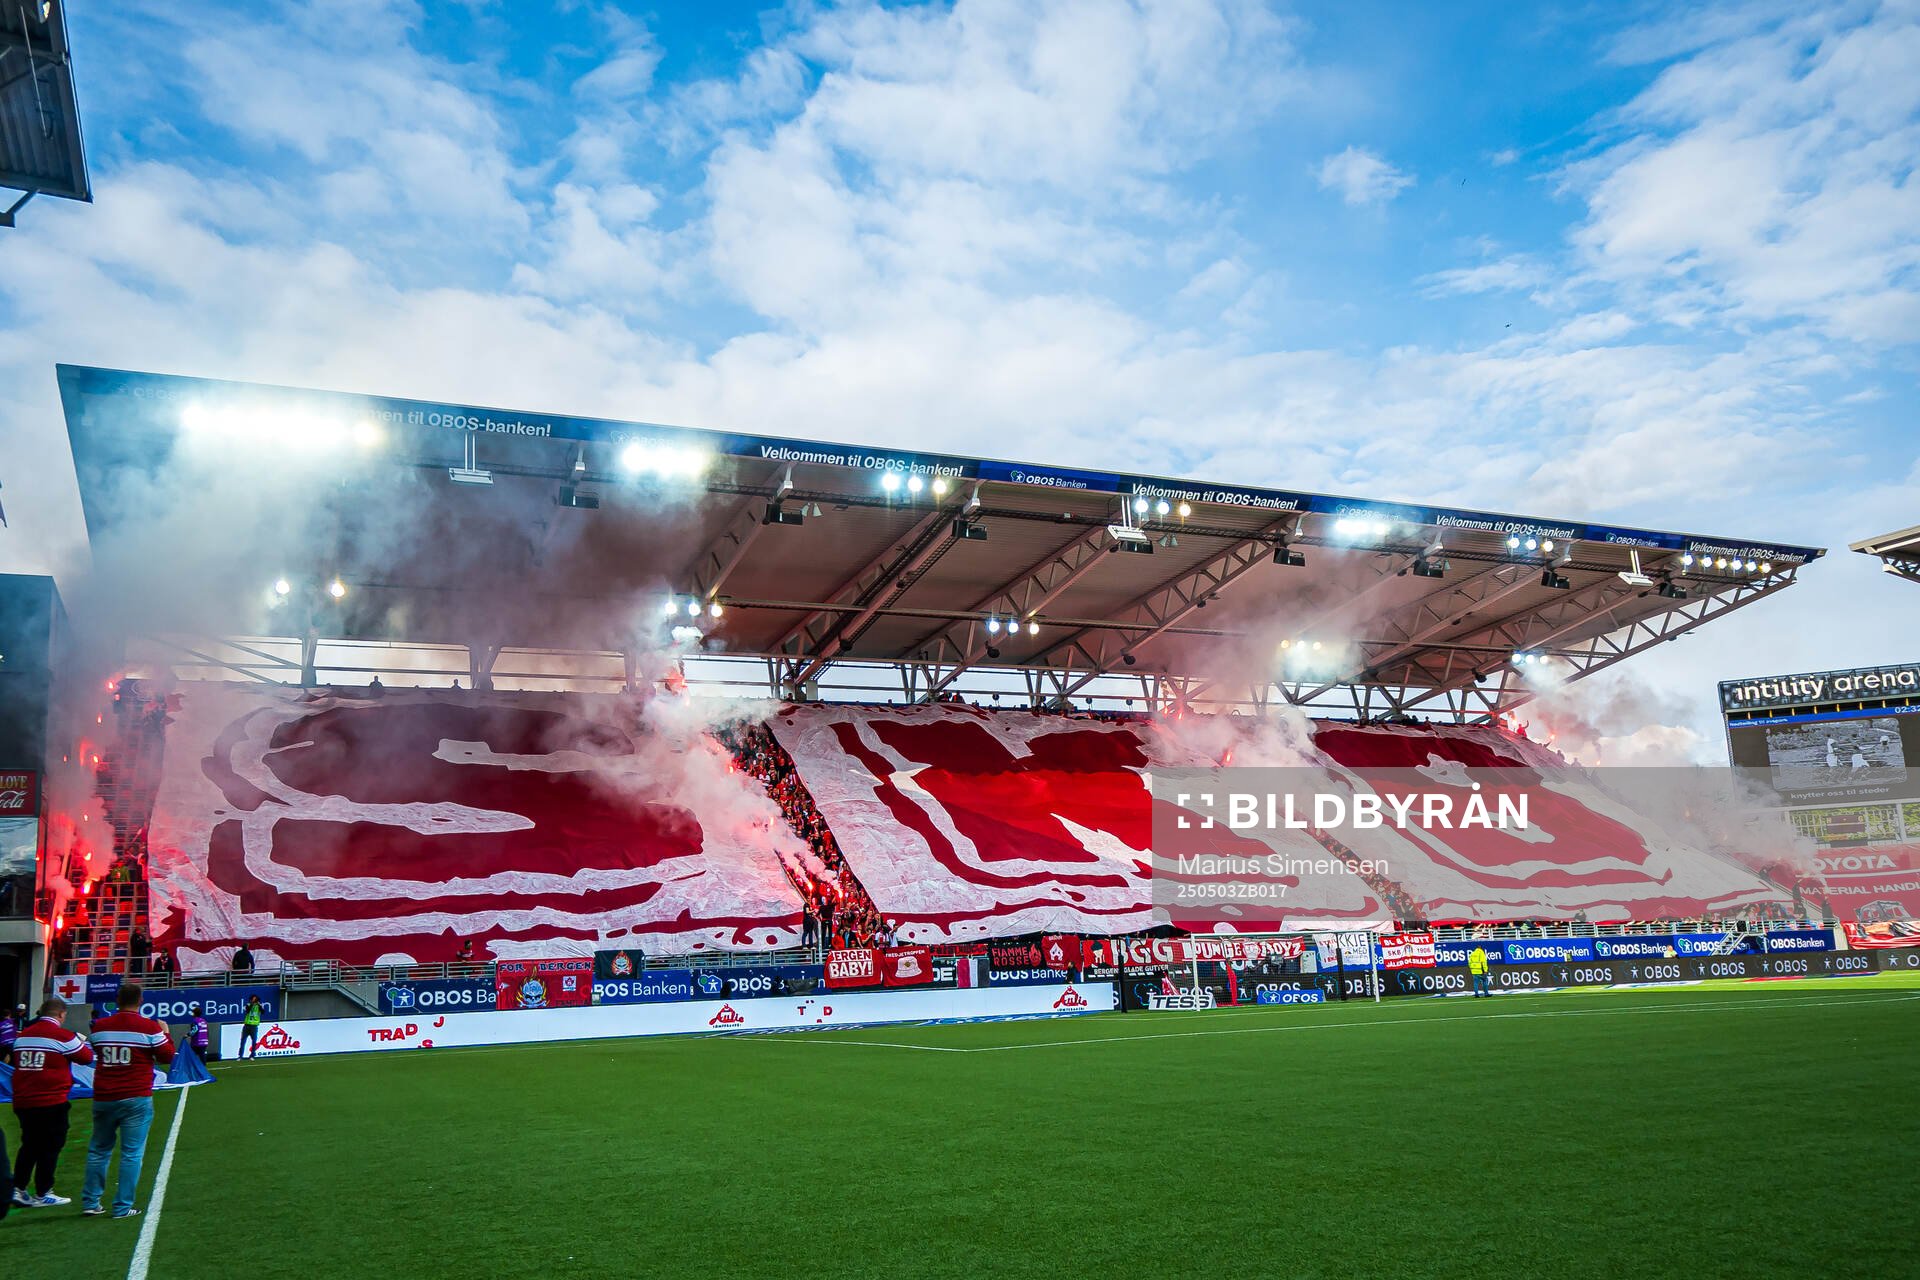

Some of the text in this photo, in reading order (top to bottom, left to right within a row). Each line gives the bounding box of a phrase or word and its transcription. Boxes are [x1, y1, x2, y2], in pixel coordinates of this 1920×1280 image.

[407, 411, 424, 425] til
[428, 412, 551, 437] OBOS-banken!
[761, 445, 964, 477] Velkommen til OBOS-banken!
[1026, 475, 1087, 489] OBOS Banken
[1132, 483, 1298, 511] Velkommen til OBOS-banken!
[1436, 514, 1574, 539] Velkommen til OBOS-banken!
[1616, 536, 1637, 546] OBOS
[1689, 541, 1807, 564] Velkommen til OBOS-banken!
[1736, 670, 1915, 700] intility arena
[1846, 788, 1857, 796] til
[1858, 786, 1890, 795] steder
[1812, 855, 1897, 871] OYOTA
[1799, 885, 1871, 895] MATERIAL
[1612, 943, 1667, 955] OBOS Banke
[1770, 936, 1825, 949] OBOS Banken
[1435, 950, 1466, 963] OBOS
[1526, 947, 1556, 959] OBOS
[500, 961, 591, 972] FOR BERGEN
[994, 956, 1029, 966] ROSSE
[1774, 959, 1808, 973] OBOS
[1836, 956, 1868, 970] OBOS
[830, 961, 873, 978] BABY!
[1031, 968, 1067, 979] Banke
[1574, 967, 1612, 983] OBOS
[1644, 965, 1681, 980] OBOS
[1711, 962, 1746, 976] OBOS
[1423, 974, 1466, 990] OBOS
[1500, 971, 1541, 987] OBOS
[593, 981, 687, 997] BOS Banken
[418, 990, 473, 1006] OBOS
[1151, 995, 1210, 1008] TESS
[140, 998, 271, 1018] OBOS Bankn
[19, 1050, 45, 1068] SLO
[102, 1046, 131, 1063] SLO
